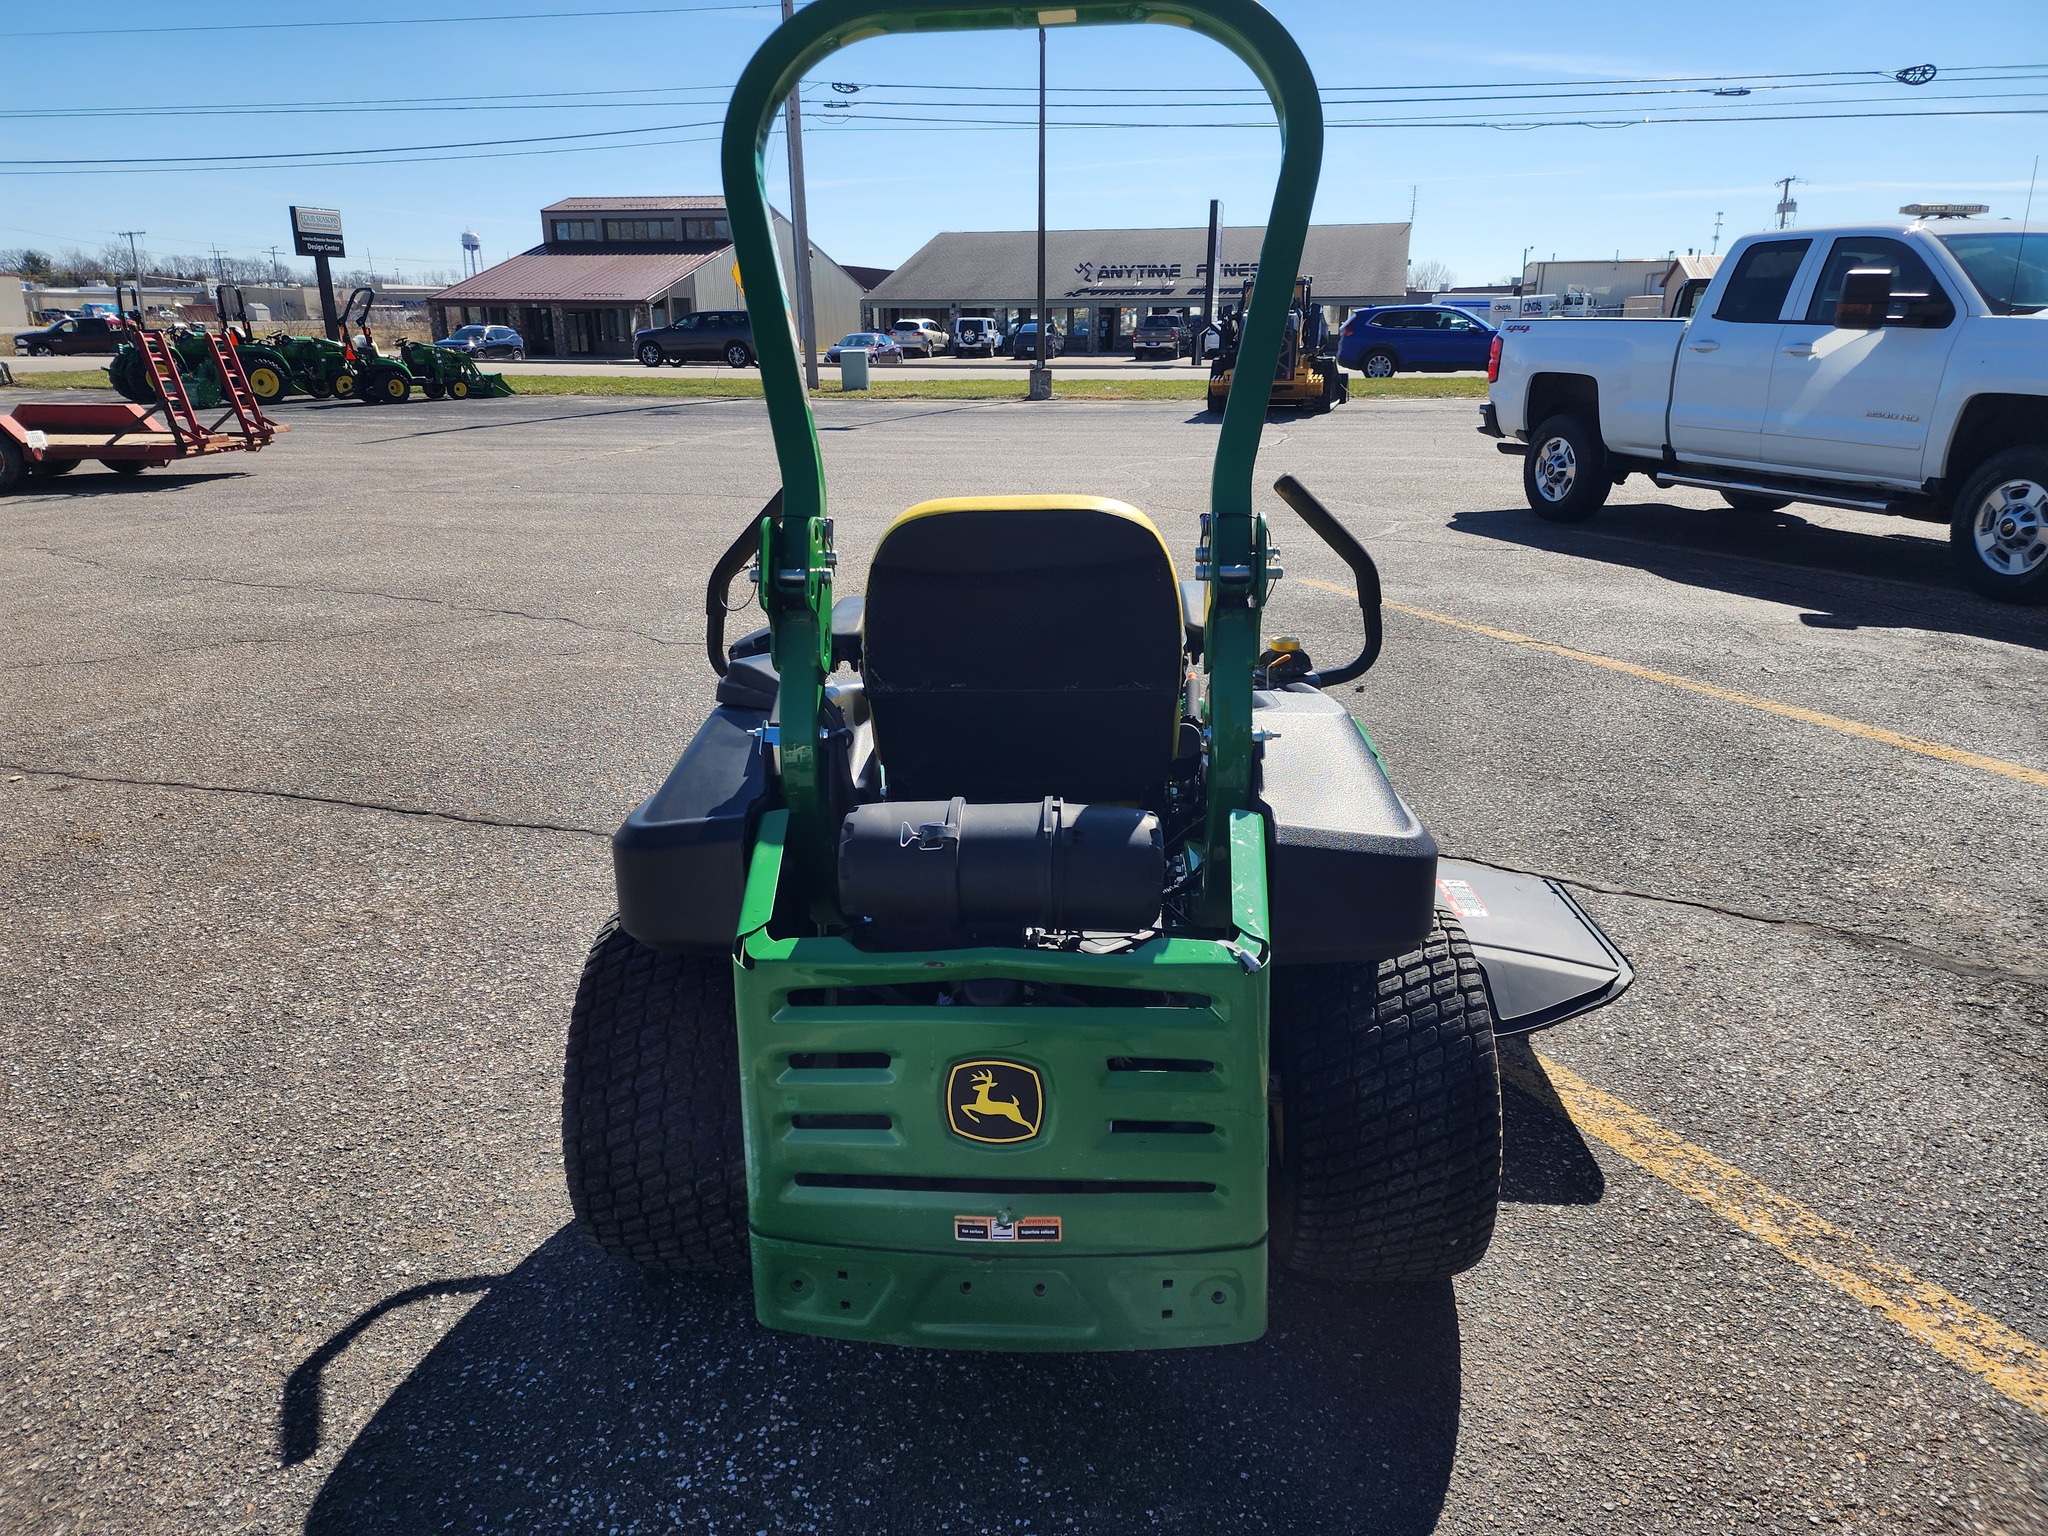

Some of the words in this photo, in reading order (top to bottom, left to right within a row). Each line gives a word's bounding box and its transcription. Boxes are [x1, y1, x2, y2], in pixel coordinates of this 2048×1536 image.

[301, 214, 316, 222] FOUR
[316, 216, 339, 224] SEASONS
[307, 243, 324, 252] Design
[1097, 264, 1181, 279] ANYTIME
[1196, 263, 1259, 278] FNES
[1523, 300, 1542, 312] CINTAS
[1866, 411, 1899, 420] 2500
[1900, 414, 1920, 423] HD
